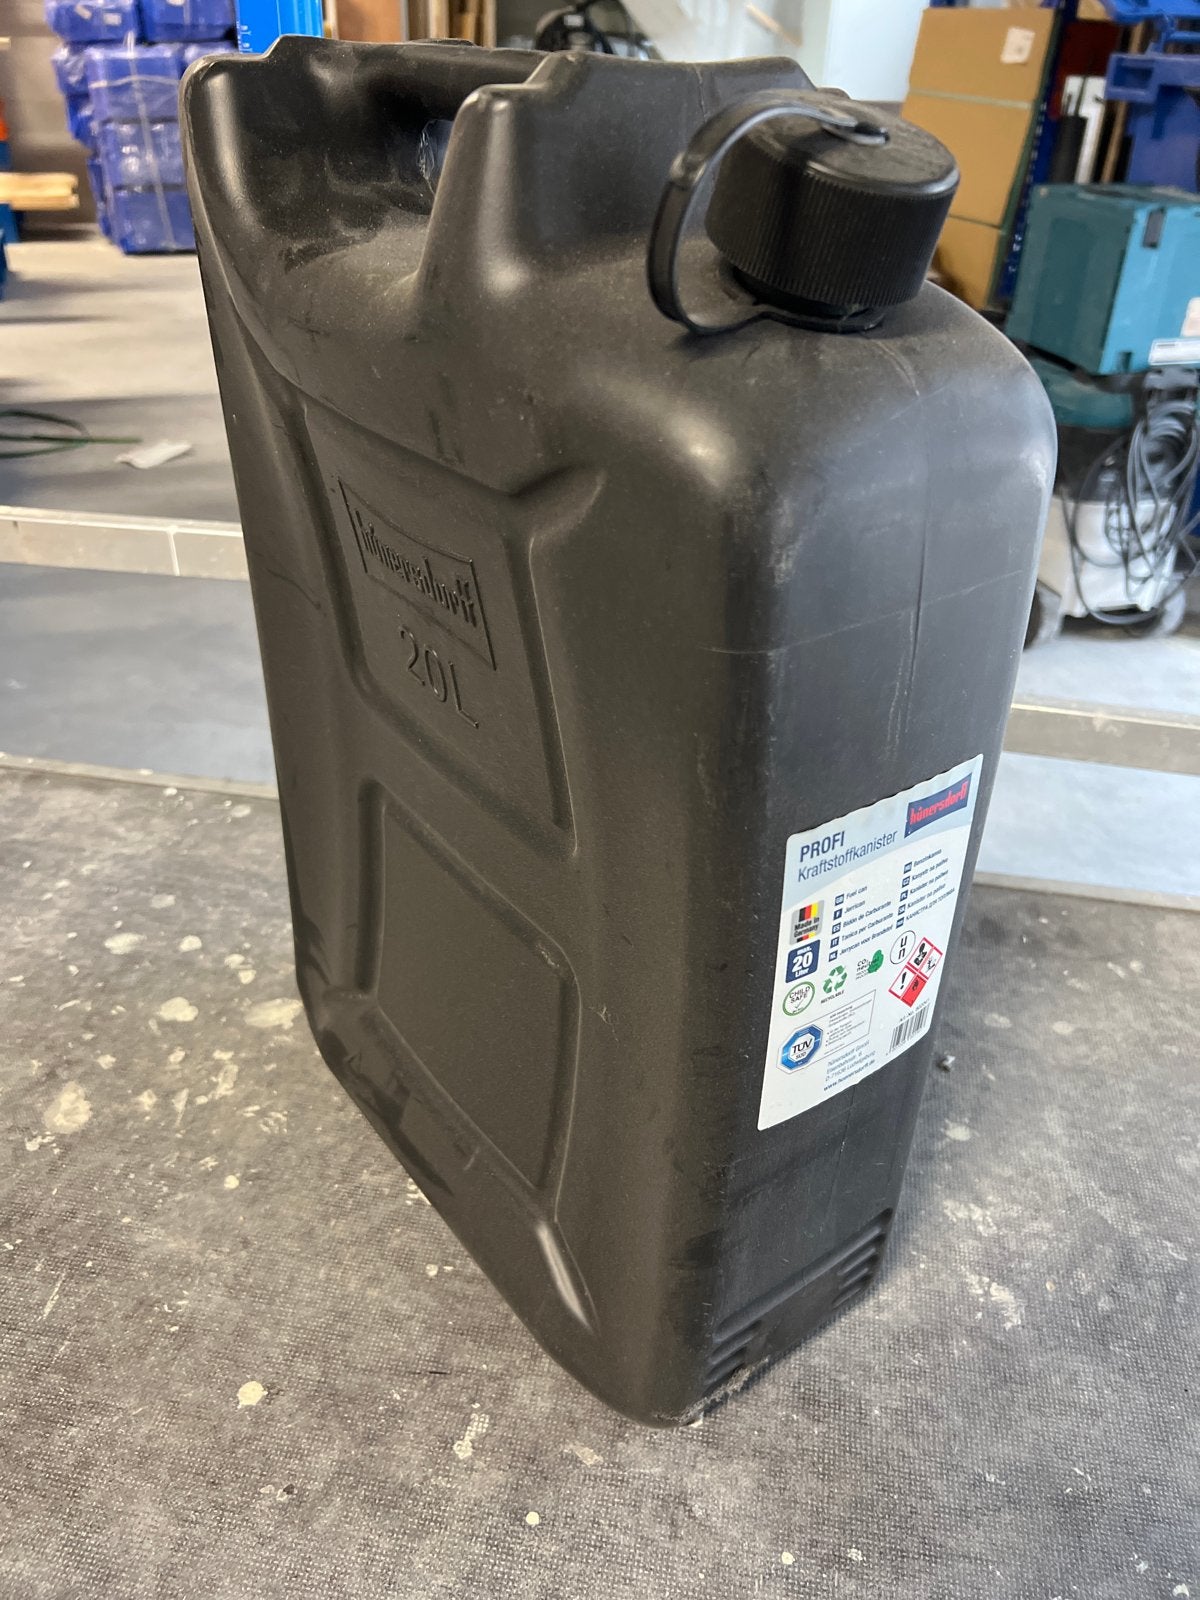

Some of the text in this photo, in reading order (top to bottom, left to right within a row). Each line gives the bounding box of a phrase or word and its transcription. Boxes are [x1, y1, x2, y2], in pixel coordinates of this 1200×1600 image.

[398, 624, 479, 728] 20L
[910, 780, 969, 825] hünersdorff
[800, 830, 845, 863] PROFI
[798, 830, 897, 882] Kraftstoffkanister
[846, 886, 867, 900] Fuel can
[793, 924, 819, 938] Germany
[794, 916, 820, 931] Made in
[791, 951, 814, 973] 20
[795, 967, 810, 978] Liter
[789, 985, 811, 999] CHILD
[790, 993, 808, 1003] SAFE
